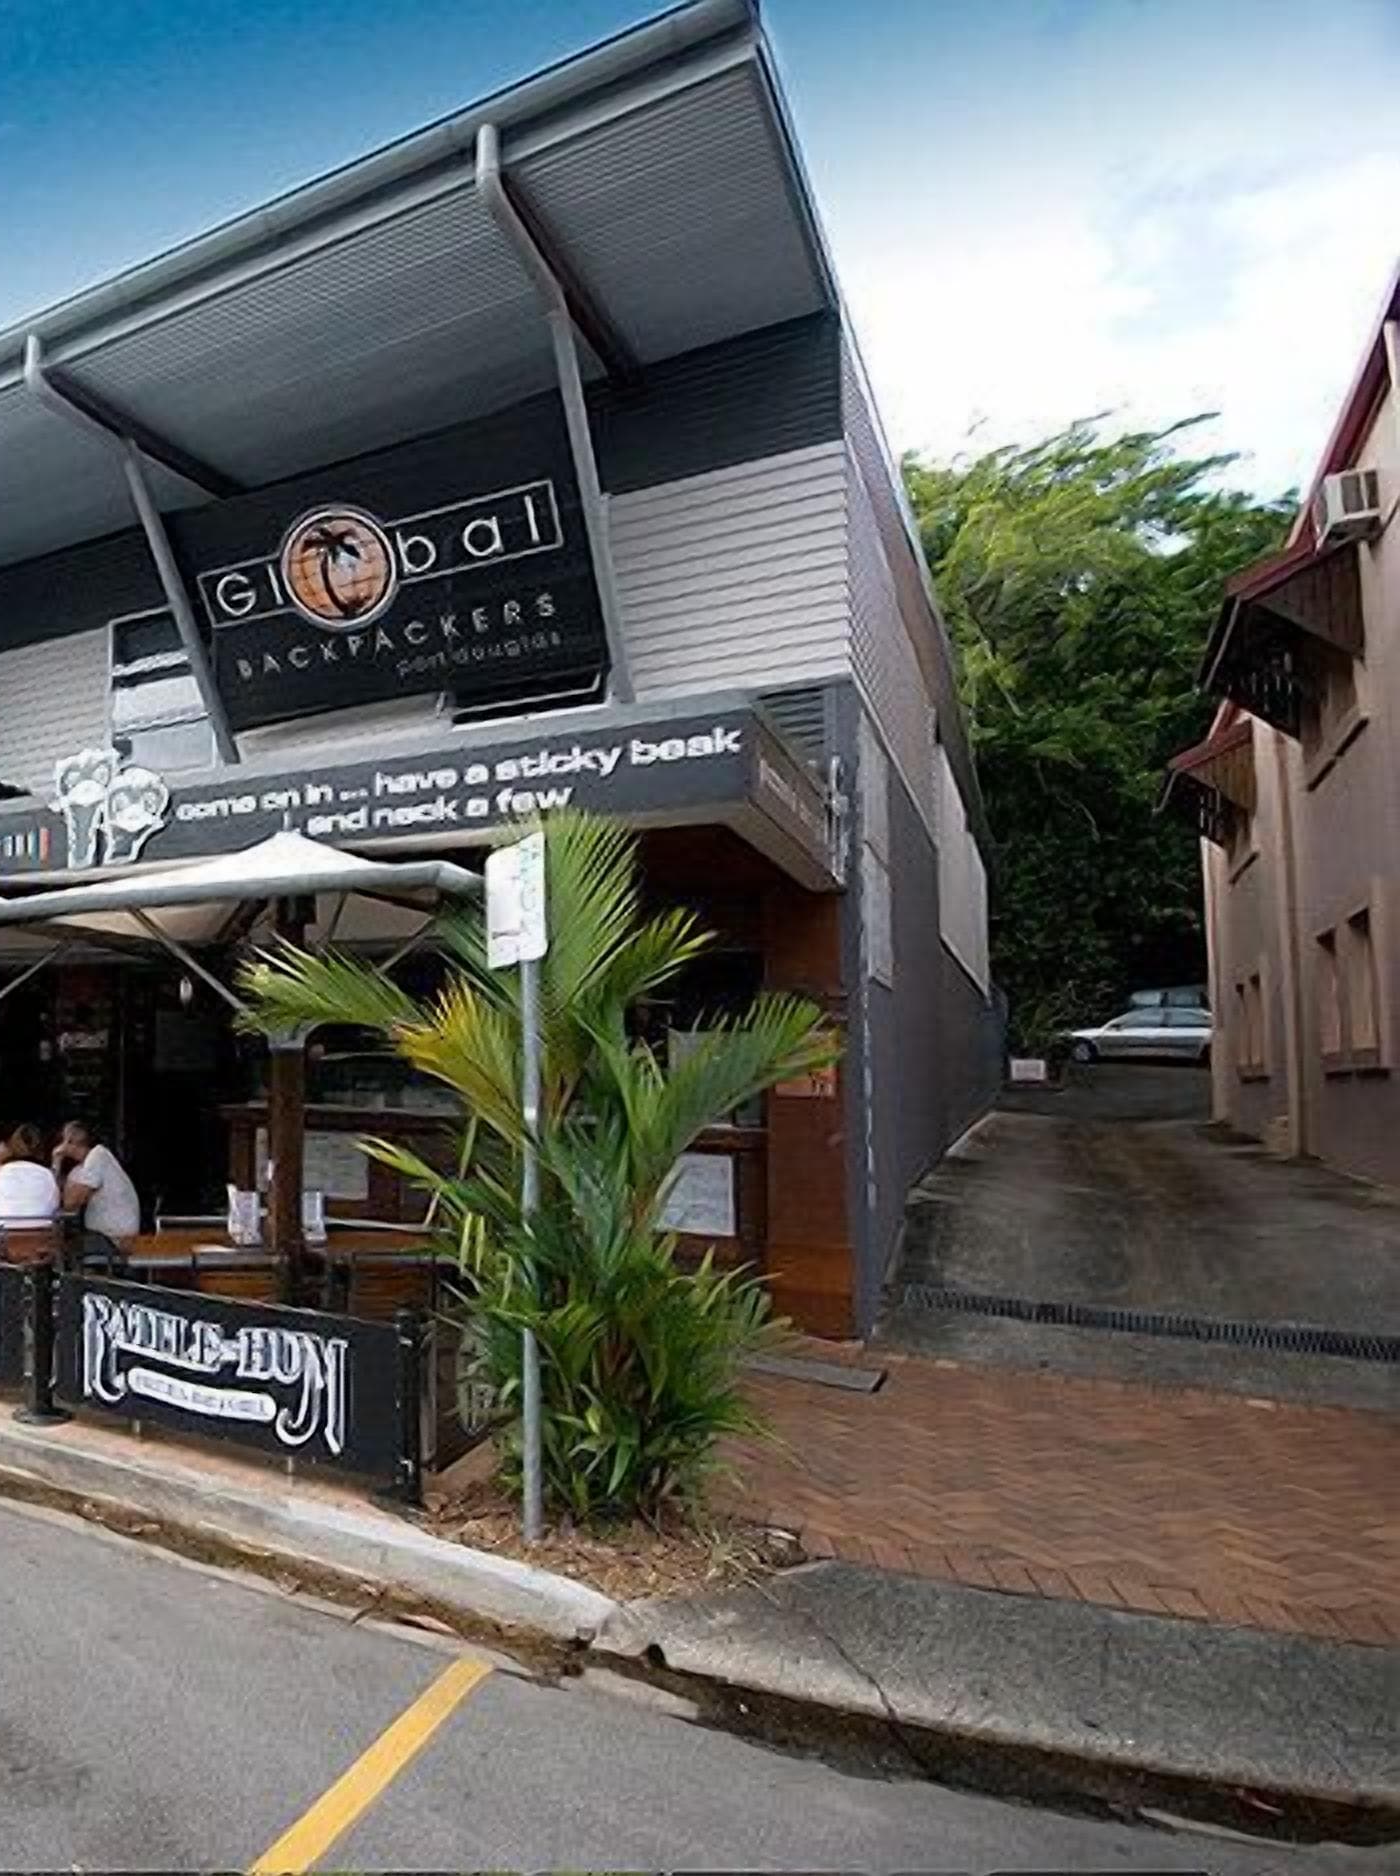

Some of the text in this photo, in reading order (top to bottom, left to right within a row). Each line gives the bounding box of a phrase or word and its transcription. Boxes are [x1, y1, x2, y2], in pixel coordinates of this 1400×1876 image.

[236, 593, 557, 682] BACKPACKERS
[176, 795, 257, 820] come
[260, 788, 300, 810] on
[375, 767, 458, 798] have
[463, 763, 489, 786] a
[495, 746, 621, 780] sticky
[630, 727, 742, 766] beak
[307, 786, 574, 836] and neck a few
